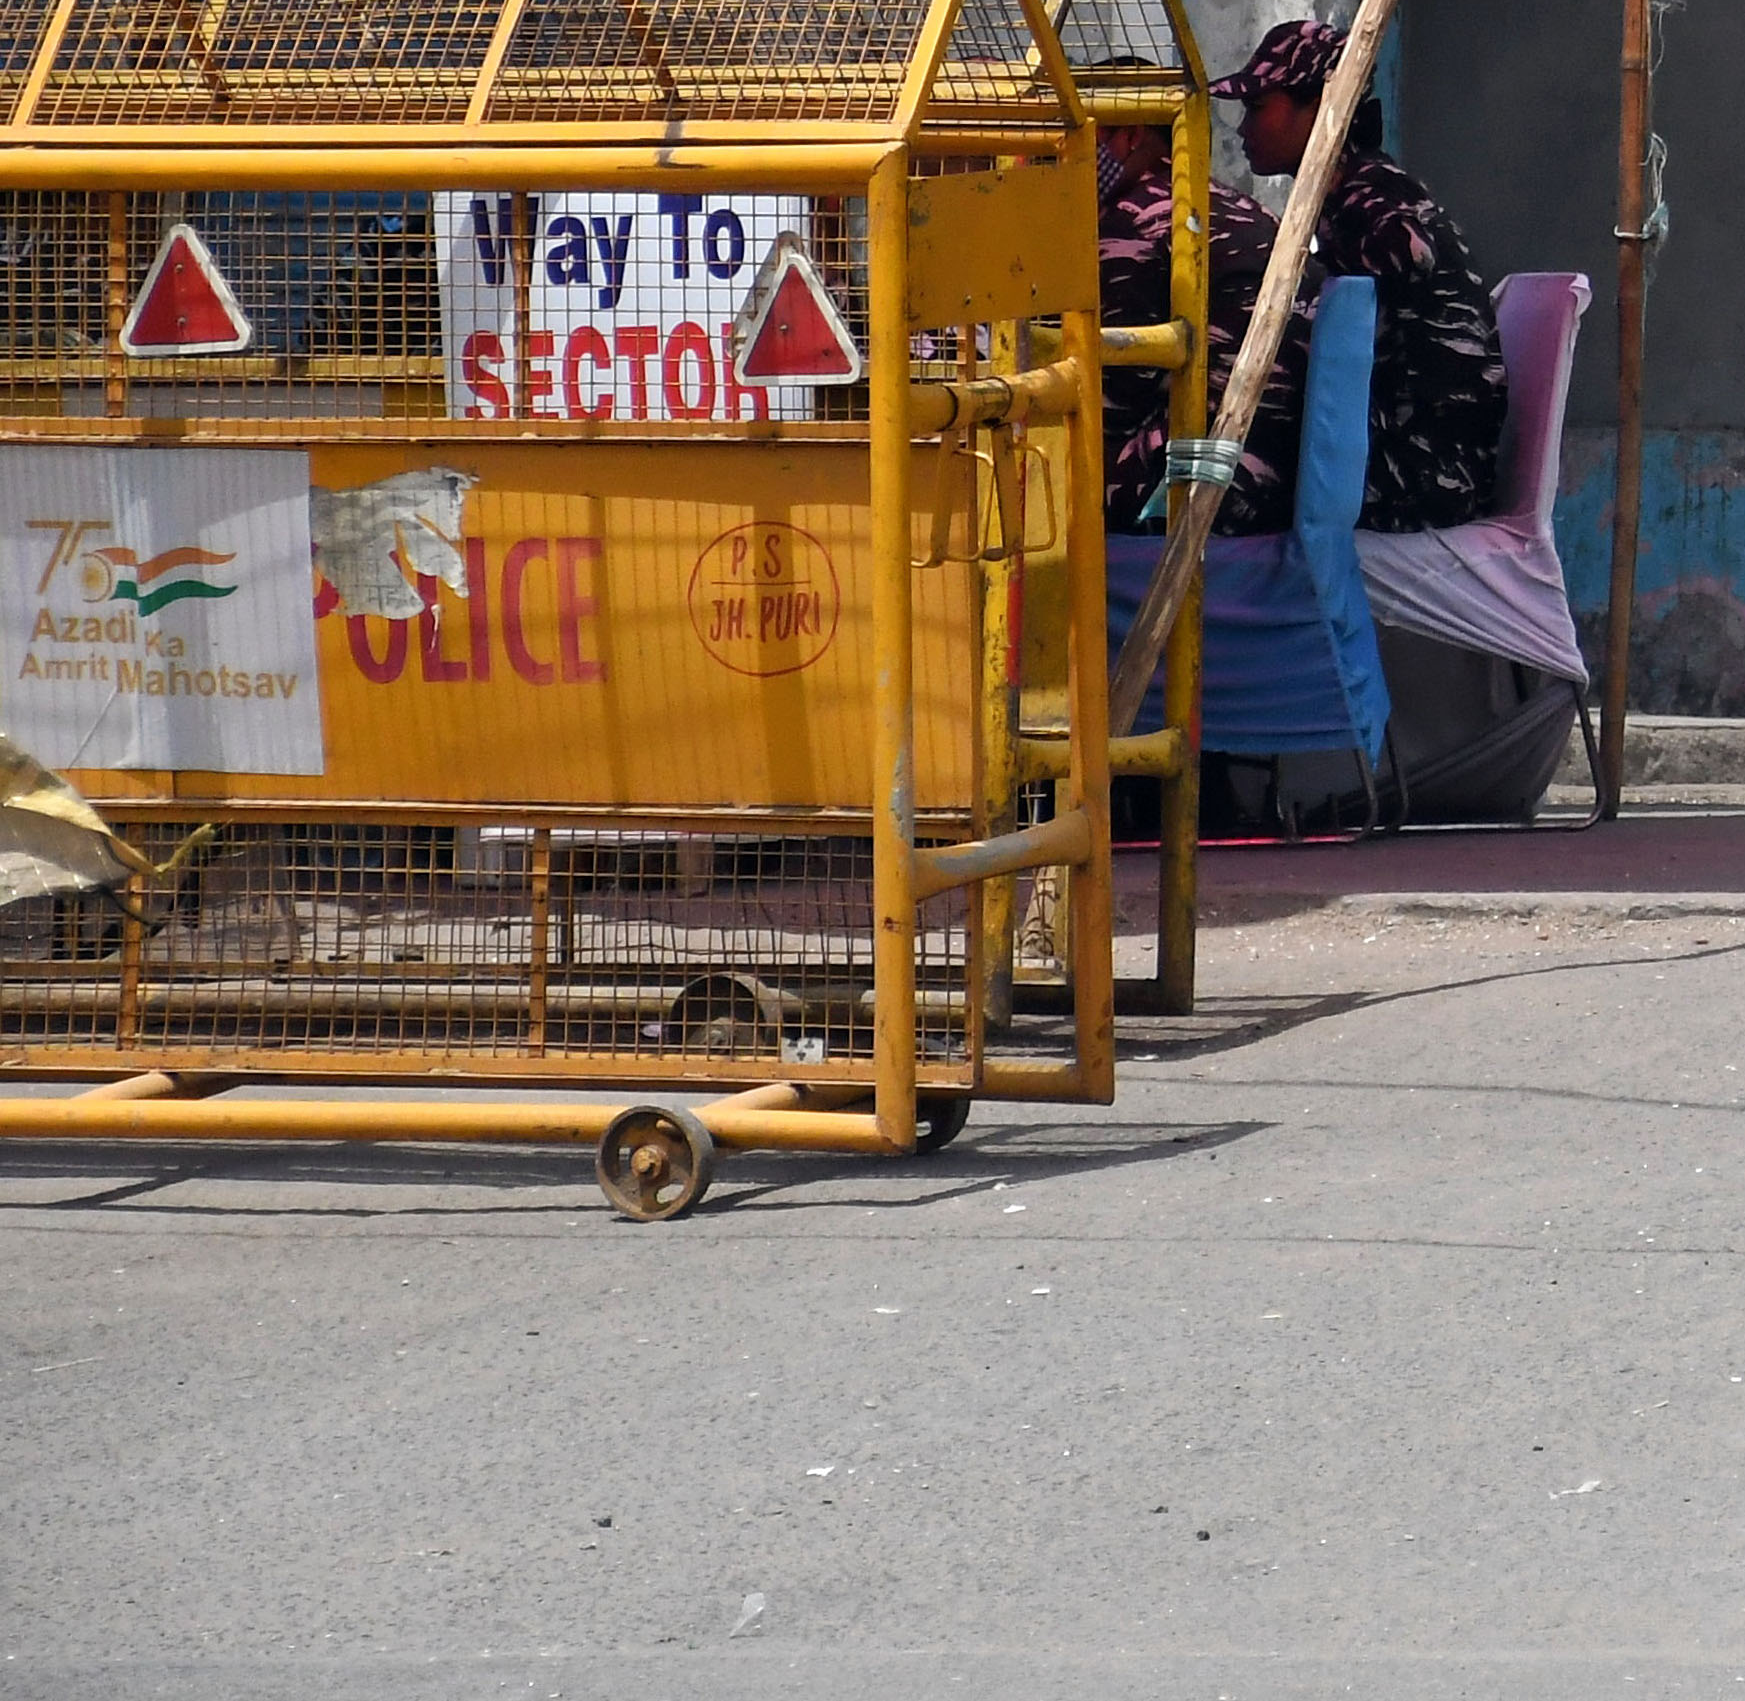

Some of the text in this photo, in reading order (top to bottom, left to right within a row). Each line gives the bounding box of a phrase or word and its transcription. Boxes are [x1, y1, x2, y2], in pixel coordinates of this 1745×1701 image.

[469, 194, 745, 310] Way To
[31, 608, 186, 658] Azadi Ka
[709, 591, 822, 644] JH. PURI
[19, 652, 298, 700] Amrit Mahotsav
